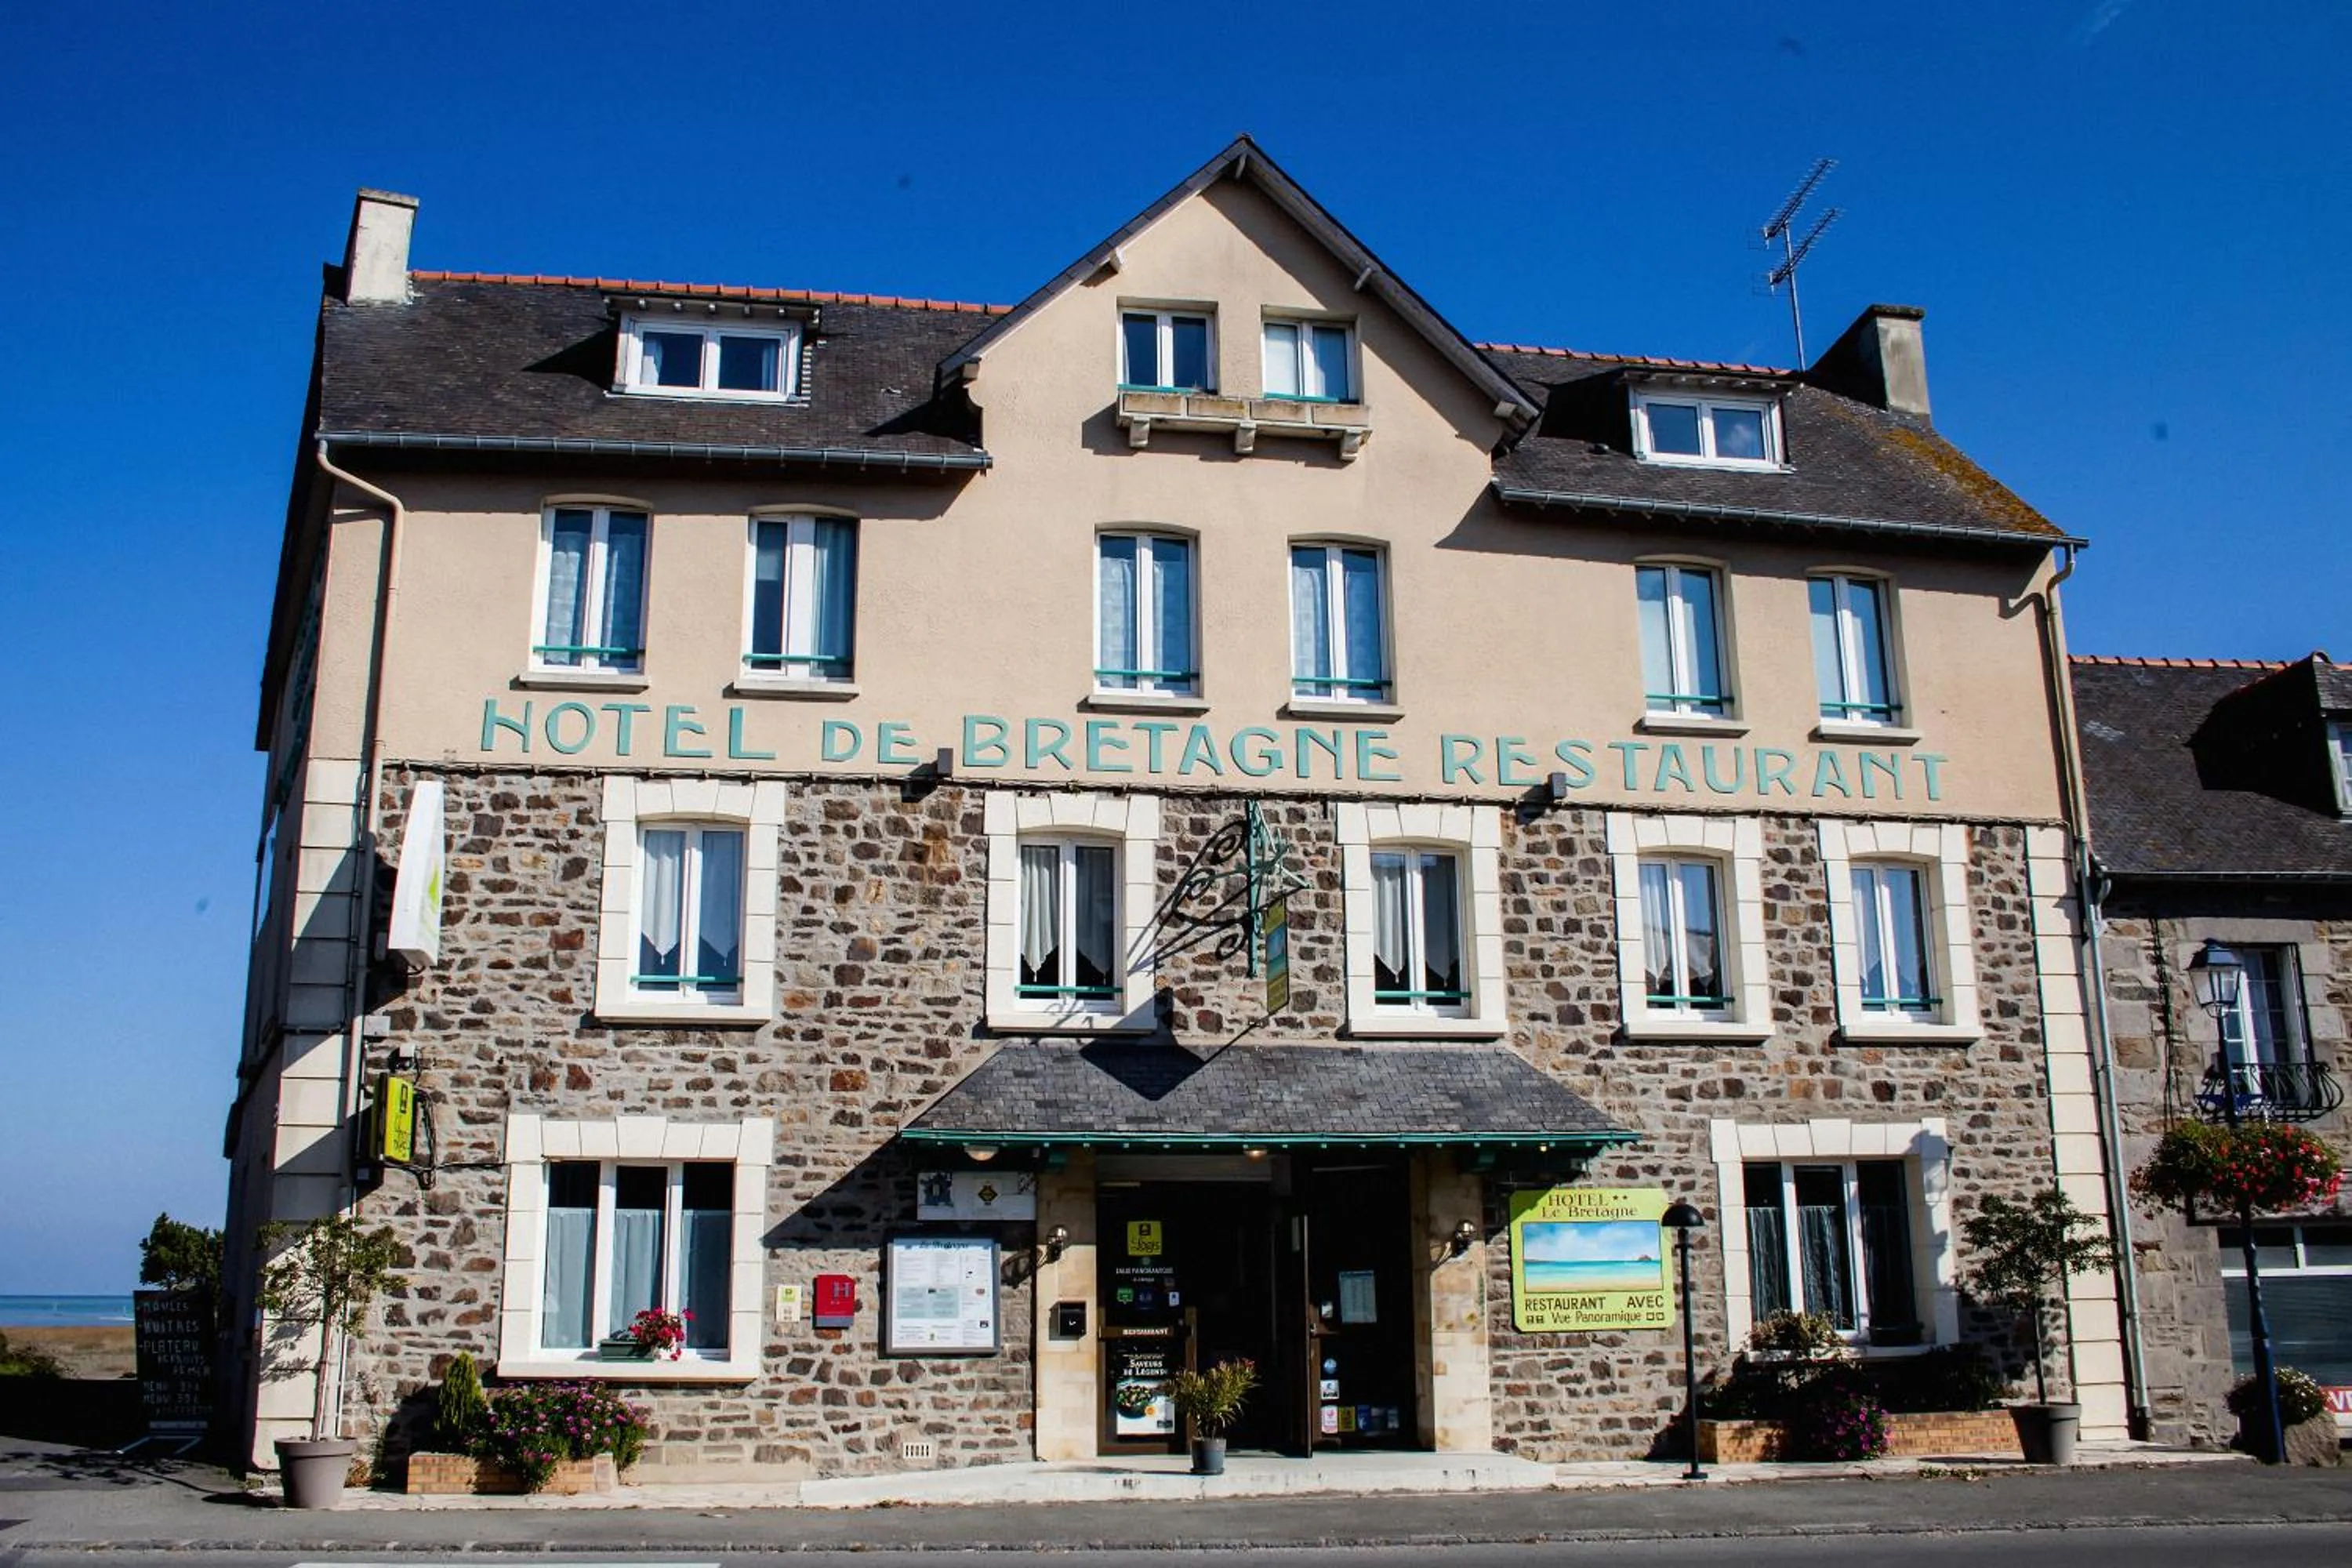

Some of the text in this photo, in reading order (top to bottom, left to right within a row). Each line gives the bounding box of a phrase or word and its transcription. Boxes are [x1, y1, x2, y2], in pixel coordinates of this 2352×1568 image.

[481, 699, 1948, 800] HOTEL DE BRETAGNE RESTAURANT
[1548, 1193, 1608, 1207] HOTEL
[1542, 1206, 1639, 1220] Le Bretagne
[1525, 1295, 1664, 1312] RESTAURANT AVEC
[1552, 1311, 1641, 1325] Vue Panoramique
[143, 1338, 200, 1354] PLATEAU
